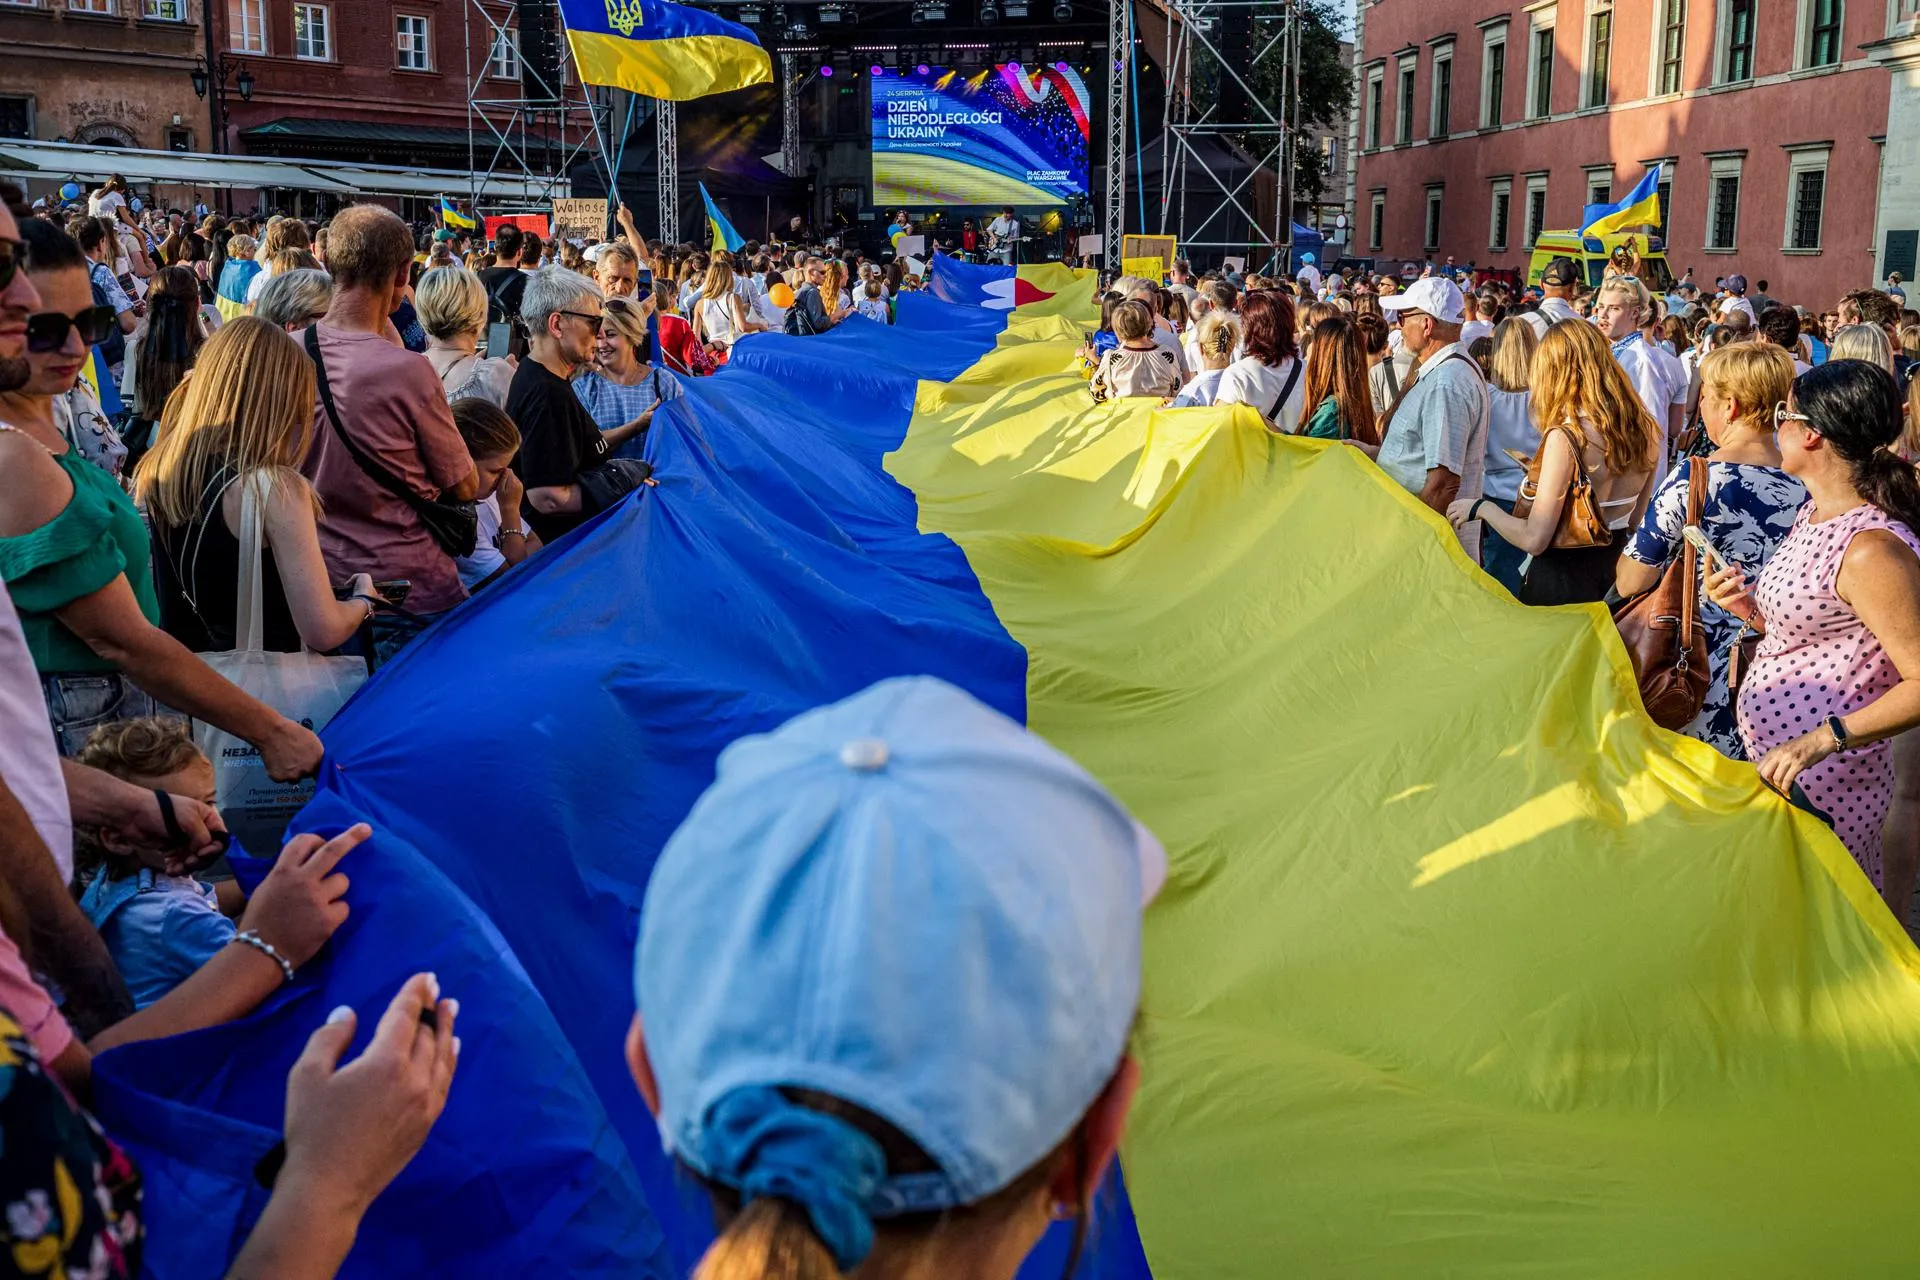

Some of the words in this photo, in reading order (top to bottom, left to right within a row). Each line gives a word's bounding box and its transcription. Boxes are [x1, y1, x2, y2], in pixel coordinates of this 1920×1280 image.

[888, 97, 927, 112] DZIEŃ
[888, 109, 1001, 125] NIEPODLEGŁOŚCI
[888, 126, 946, 138] UKRAINY
[222, 747, 261, 757] НЕЗА
